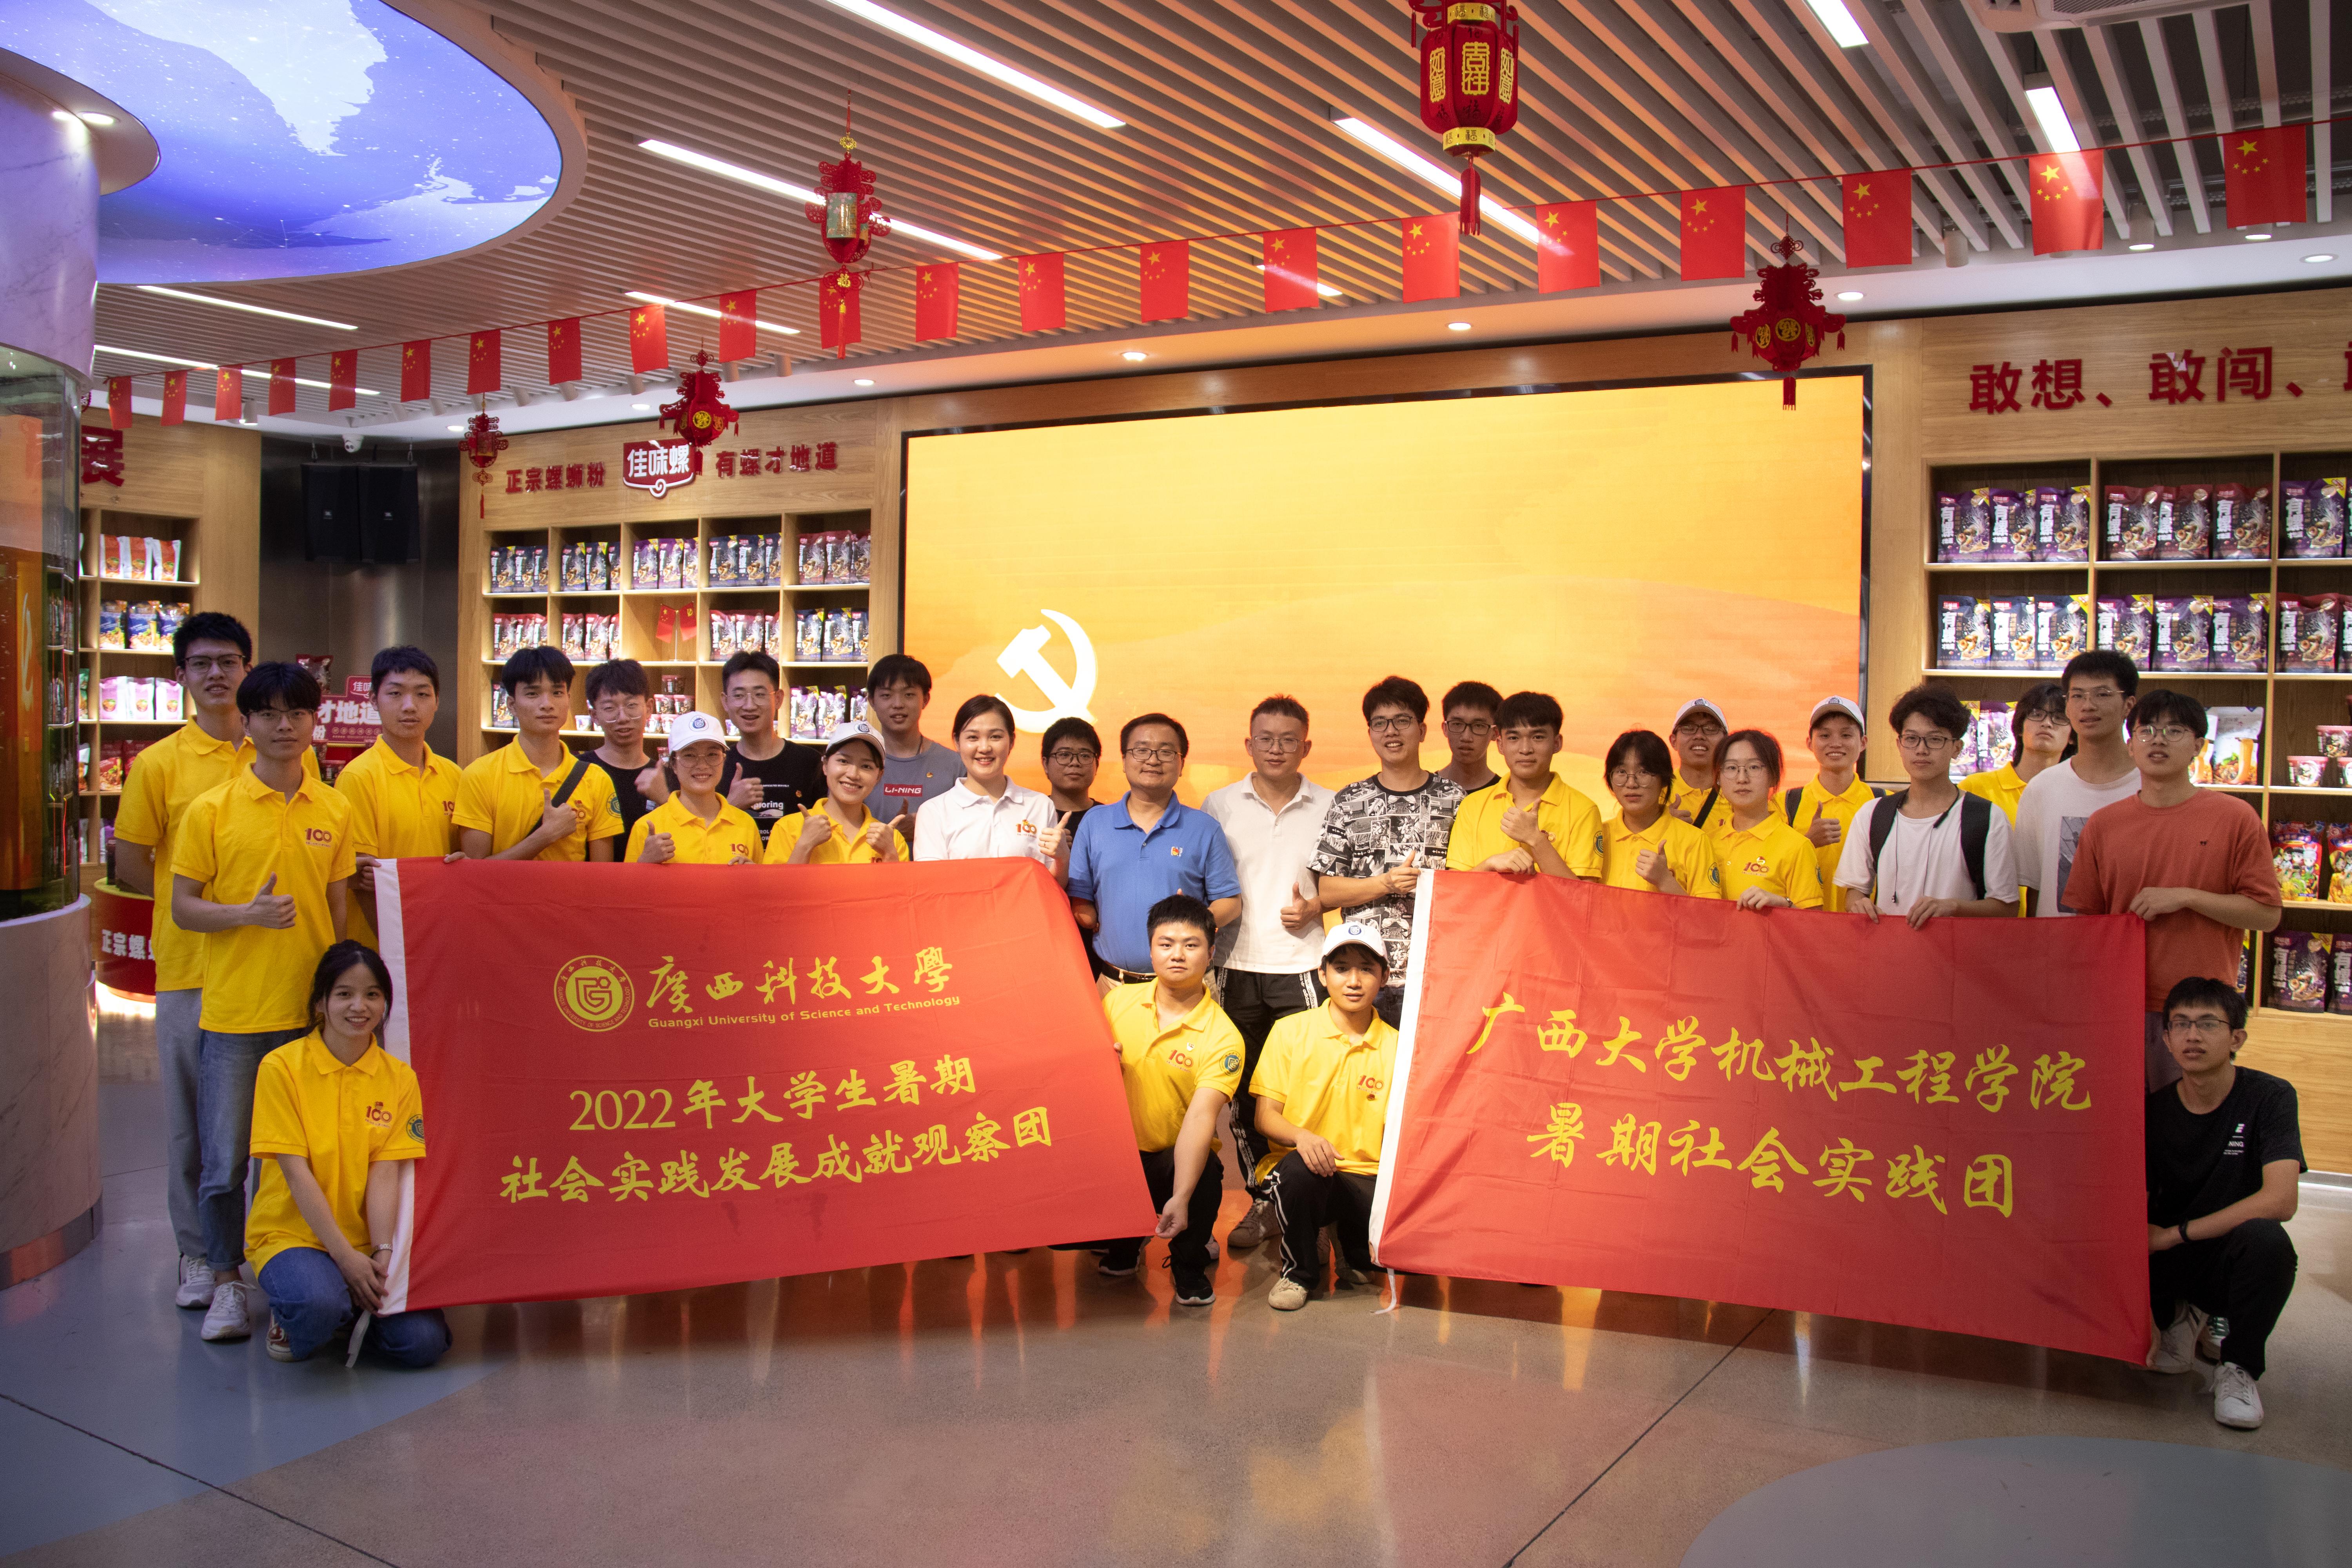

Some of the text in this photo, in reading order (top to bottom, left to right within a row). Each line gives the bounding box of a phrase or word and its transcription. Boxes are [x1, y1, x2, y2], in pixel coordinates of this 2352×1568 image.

[1969, 340, 2352, 414] 敢想、敢闯、
[627, 444, 690, 477] 佳味螺
[716, 442, 837, 477] 有螺才地道
[506, 461, 604, 493] 正宗螺蛳粉
[318, 700, 382, 725] 才地道
[305, 828, 332, 843] 100
[1743, 862, 1769, 873] 100
[102, 929, 155, 960] 正宗螺
[595, 1020, 615, 1028] SCIENCE
[648, 996, 960, 1029] Guangxi University of Science and Technology
[1169, 1050, 1194, 1068] 100
[1466, 991, 2091, 1112] 广西大学机械工程学院
[569, 1054, 977, 1131] 2022年大学生暑期
[1358, 1075, 1384, 1091] 100
[366, 1105, 392, 1123] 100
[501, 1107, 1052, 1203] 社会实践发展成就观察团
[1526, 1102, 2013, 1218] 暑期社会实践团
